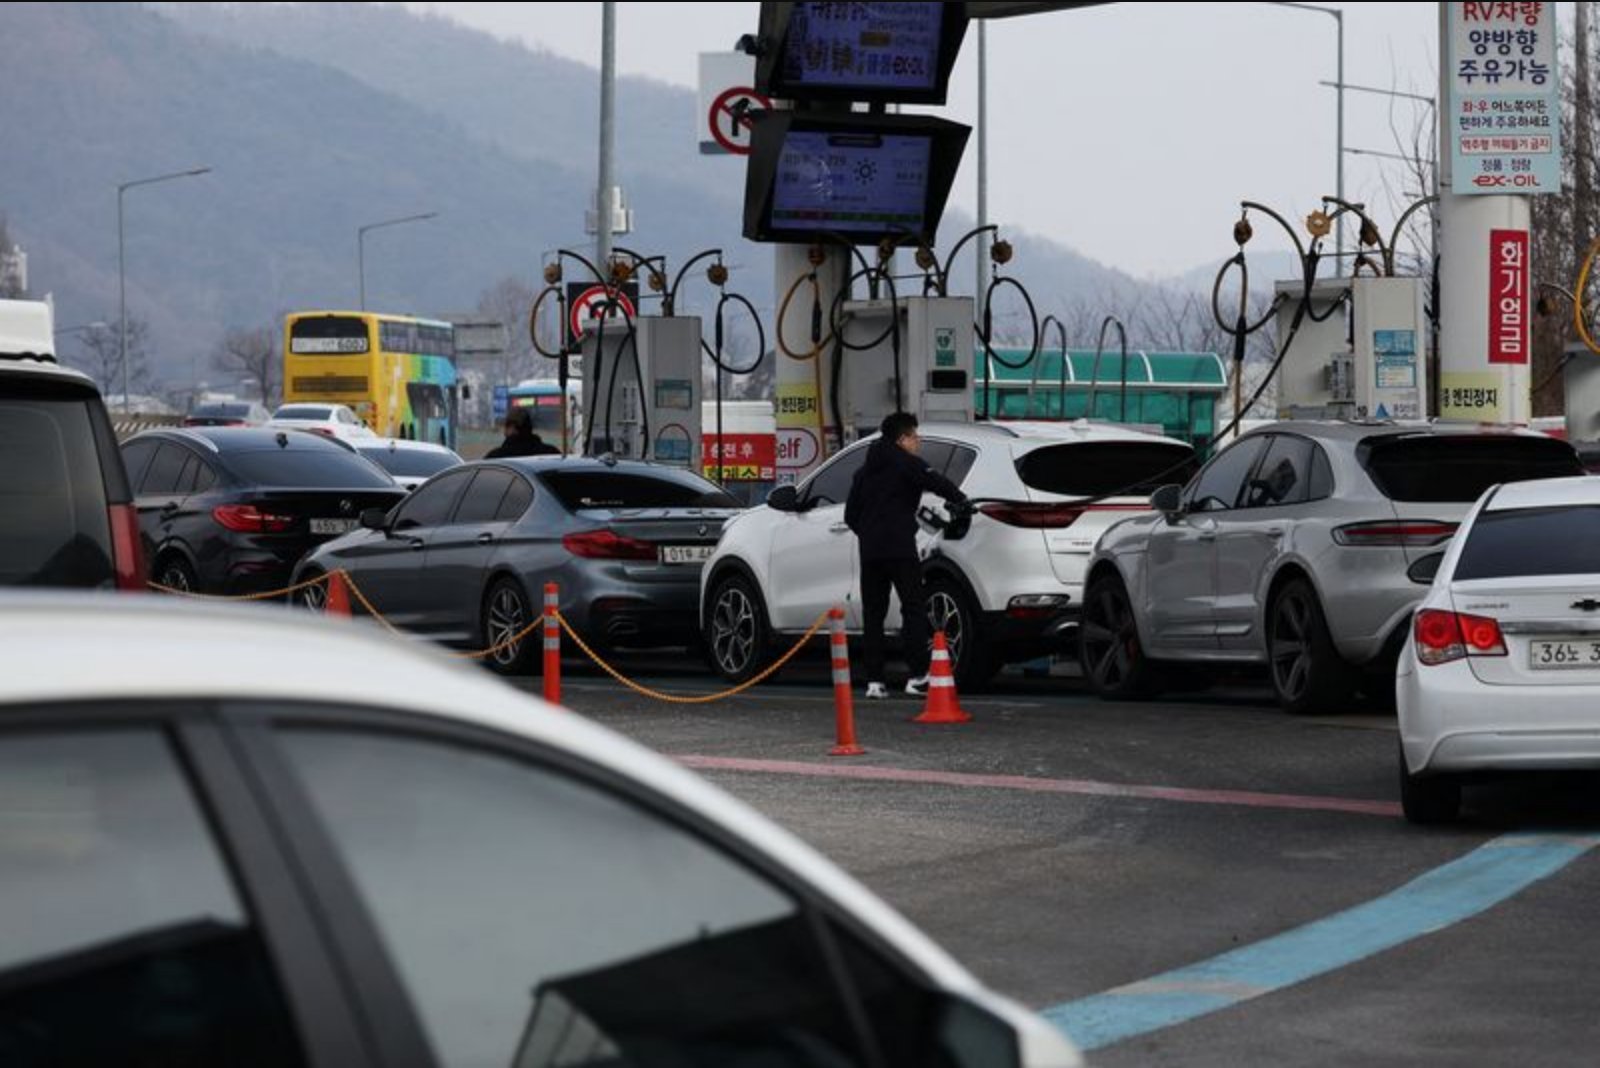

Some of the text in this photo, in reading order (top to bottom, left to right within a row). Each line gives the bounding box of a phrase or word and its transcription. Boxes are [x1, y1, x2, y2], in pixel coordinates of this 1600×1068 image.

[1463, 2, 1542, 26] RV차량
[1469, 30, 1538, 55] 양방향
[1458, 59, 1549, 85] 주유가능
[1492, 100, 1548, 114] 어느쪽이든
[1460, 116, 1550, 130] 편하게 주유하세요
[1500, 241, 1523, 353] 화기엄금
[782, 396, 817, 413] 엔진정지
[1453, 388, 1497, 408] 엔진정지
[777, 438, 802, 459] elf
[1541, 643, 1579, 663] 36노
